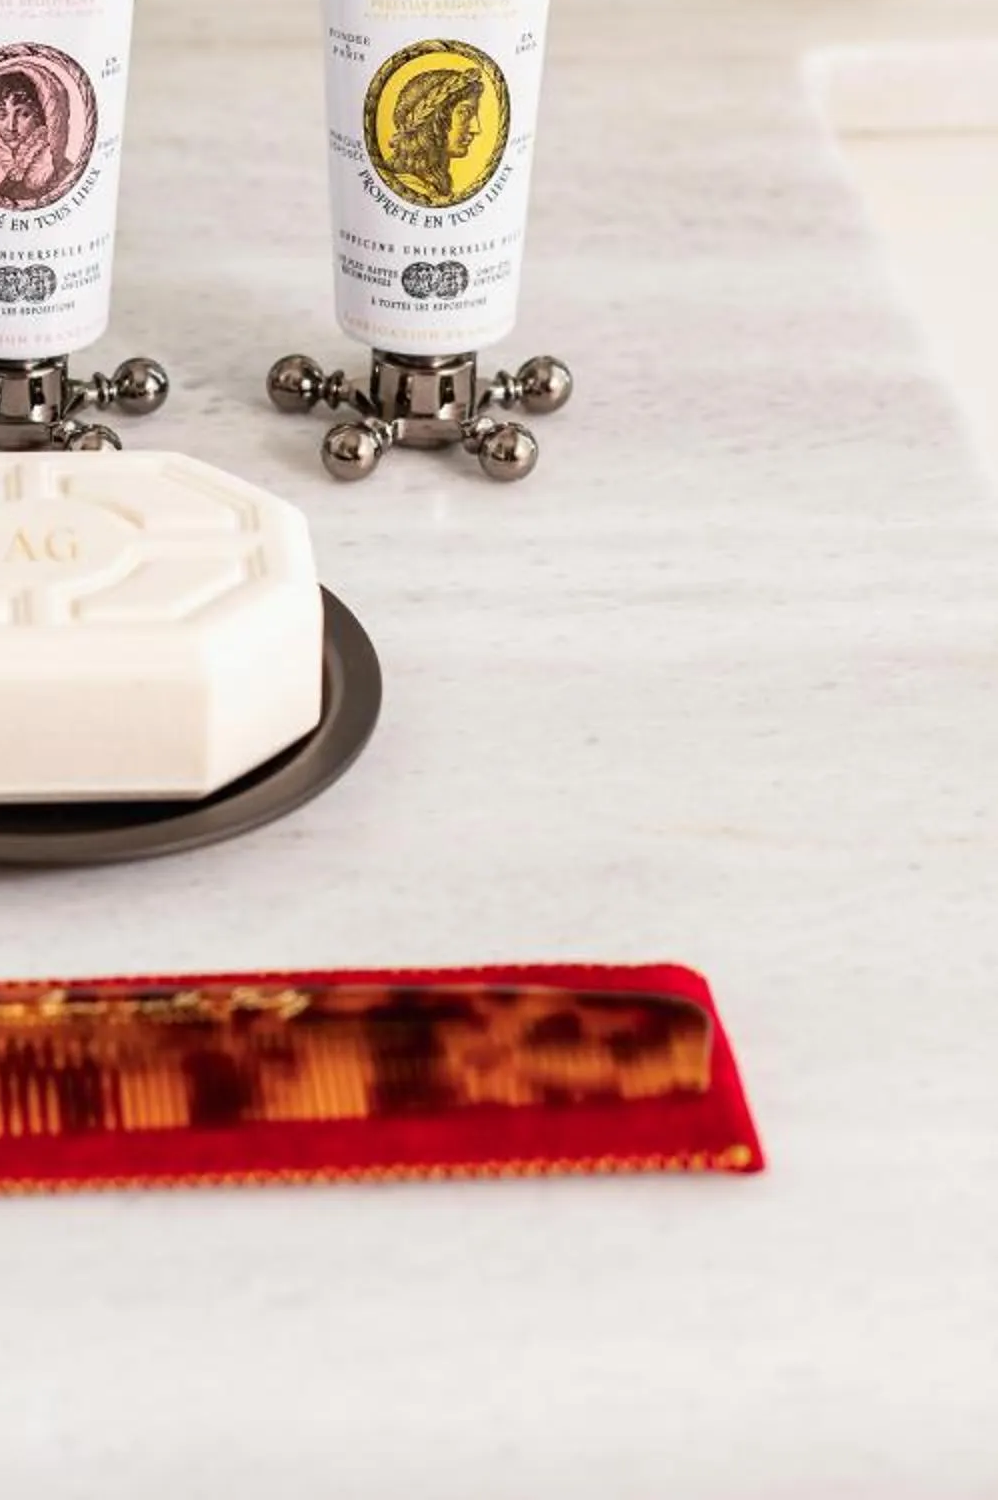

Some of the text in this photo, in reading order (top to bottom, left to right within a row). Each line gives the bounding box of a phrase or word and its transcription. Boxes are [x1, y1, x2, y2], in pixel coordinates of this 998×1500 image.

[10, 219, 30, 231] EN
[33, 206, 72, 229] TOUS
[72, 168, 101, 207] LIEUX
[358, 165, 514, 228] PROPRETÉ EN TOUS LIEUX
[2, 527, 78, 562] AG
